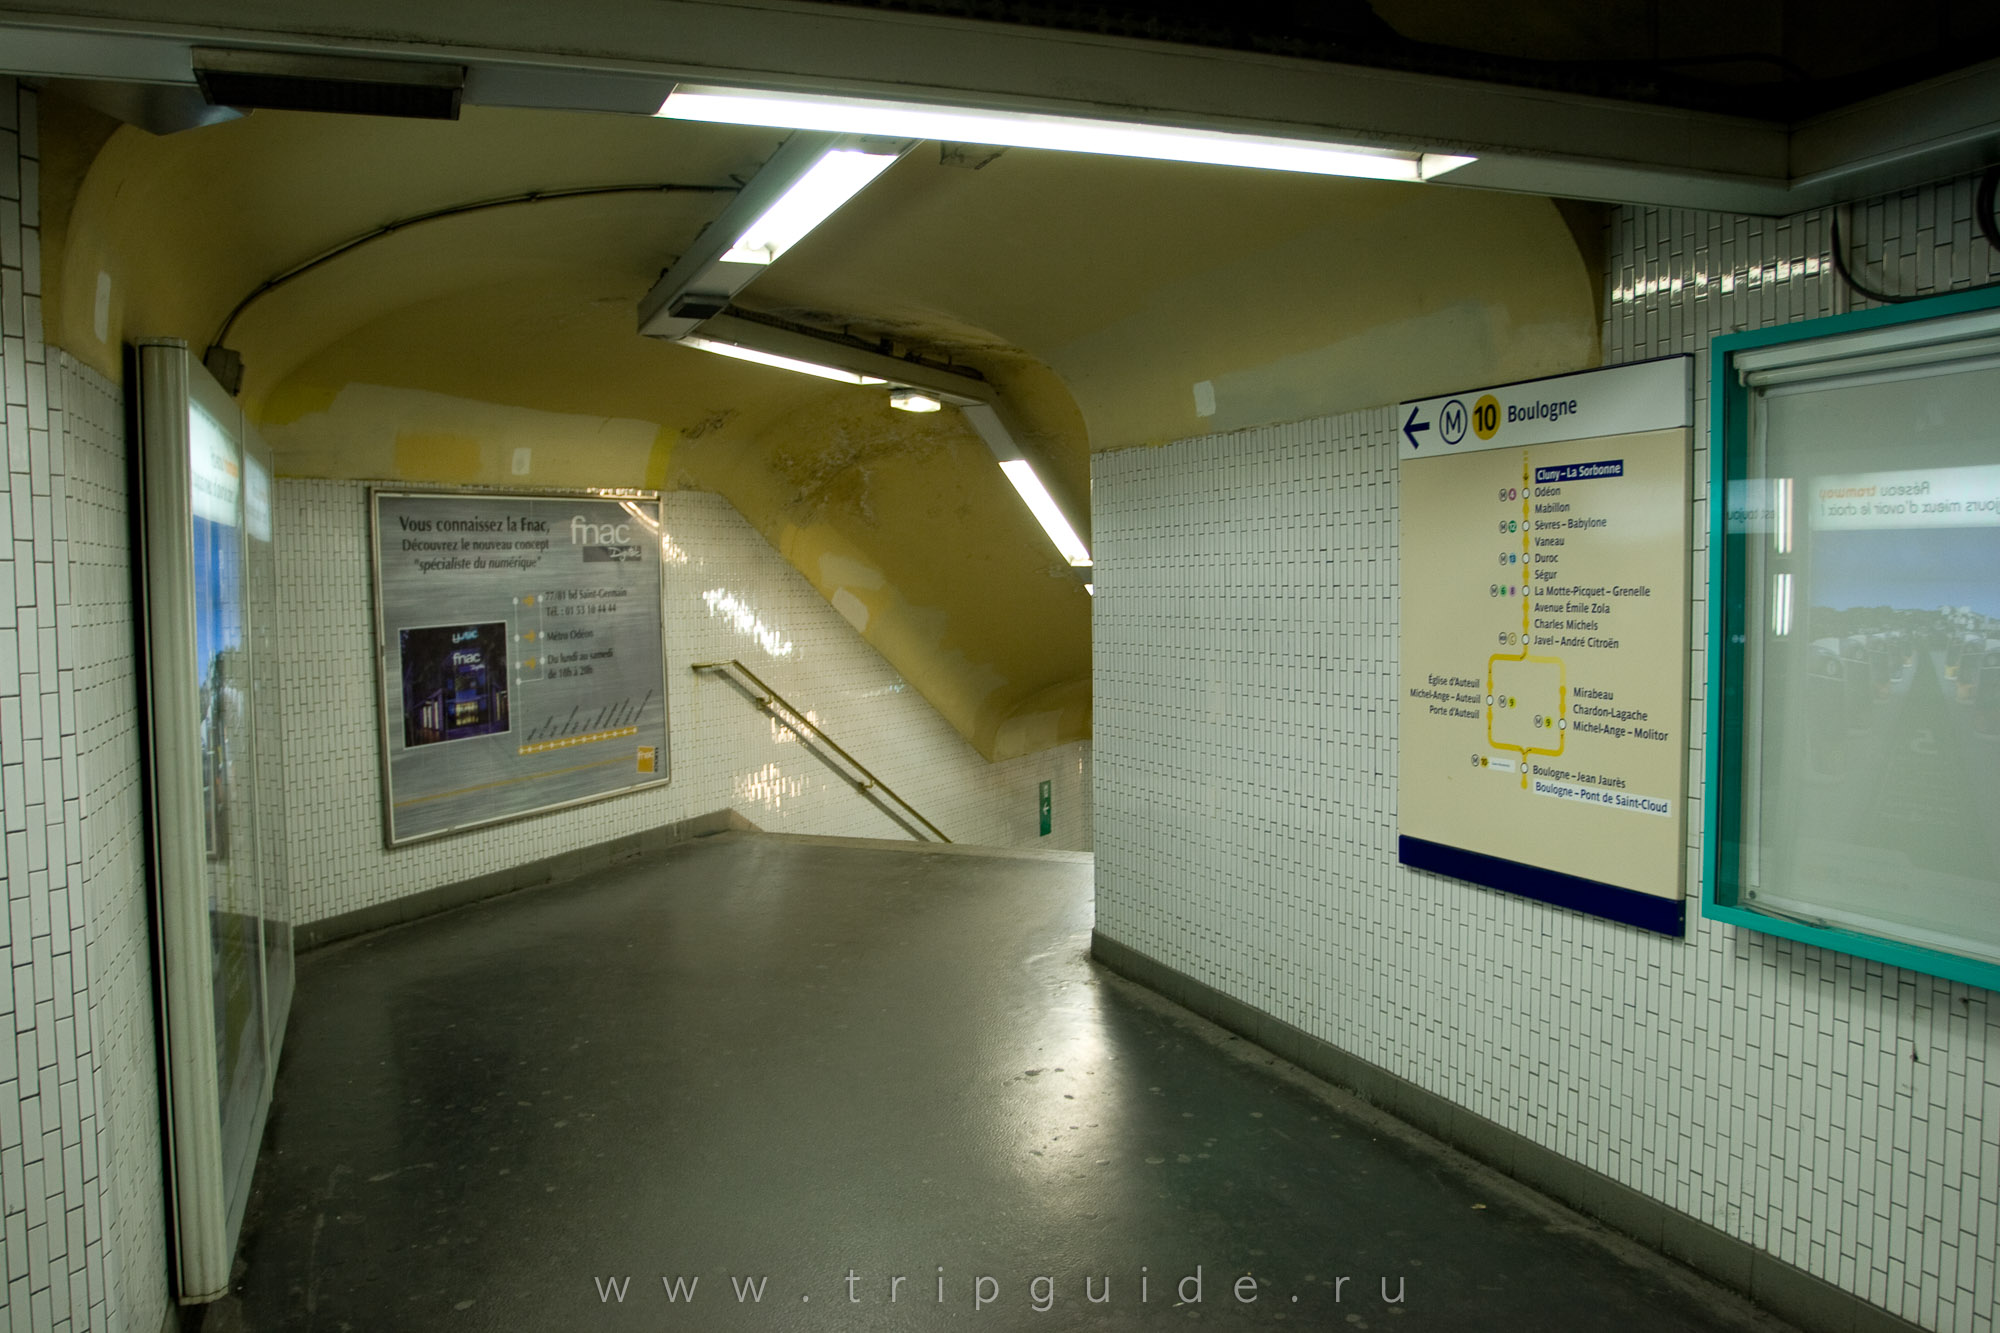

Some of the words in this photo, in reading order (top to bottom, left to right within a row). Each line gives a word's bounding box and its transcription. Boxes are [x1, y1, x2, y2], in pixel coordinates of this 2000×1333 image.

[1474, 403, 1497, 432] 10
[1507, 399, 1578, 423] Boulogne
[1536, 469, 1560, 481] Cluny
[1566, 467, 1578, 478] La
[1578, 463, 1621, 477] Sorbonne
[1534, 486, 1561, 498] Odéon
[1534, 503, 1571, 514] Mabillon
[399, 516, 433, 532] Vous
[436, 516, 504, 532] connaissez
[506, 516, 518, 532] la
[520, 517, 551, 535] Fnac,
[570, 515, 632, 545] fnac
[1534, 522, 1561, 531] Sèvres
[1567, 519, 1608, 531] Babylone
[402, 538, 457, 551] Découvrez
[460, 538, 470, 550] le
[472, 539, 513, 550] nouveau
[514, 539, 550, 553] concept
[1534, 537, 1565, 547] Vaneau
[473, 556, 487, 569] du
[1534, 553, 1559, 563] Duroc
[1534, 569, 1558, 581] Ségur
[1534, 586, 1545, 596] La
[1546, 586, 1605, 599] Motte-Picquet
[1612, 586, 1651, 597] Grenelle
[1534, 602, 1564, 613] Avenue
[1566, 601, 1589, 613] Émile
[1591, 603, 1610, 614] Zola
[1534, 619, 1564, 630] Charles
[1566, 620, 1598, 630] Michels
[1534, 635, 1554, 645] Javel
[1560, 636, 1585, 648] André
[1587, 637, 1619, 649] Citroën
[1428, 674, 1448, 687] Église
[1449, 677, 1480, 688] d'Auteuil
[1410, 688, 1450, 702] Michel-Ange
[1456, 693, 1480, 703] Auteuil
[1573, 687, 1614, 700] Mirabeau
[1429, 705, 1447, 715] Porte
[1449, 707, 1480, 719] d'Auteuil
[1573, 704, 1648, 721] Chardon-Lagache
[1573, 721, 1626, 738] Michel-Ange
[1634, 728, 1669, 741] Molitor
[1533, 765, 1570, 780] Boulogne
[1577, 772, 1596, 783] Jean
[1598, 775, 1626, 788] Jaurès
[1536, 781, 1573, 797] Boulogne
[1580, 789, 1600, 802] Pont
[1602, 793, 1613, 804] de
[1615, 795, 1668, 813] Saint-Cloud
